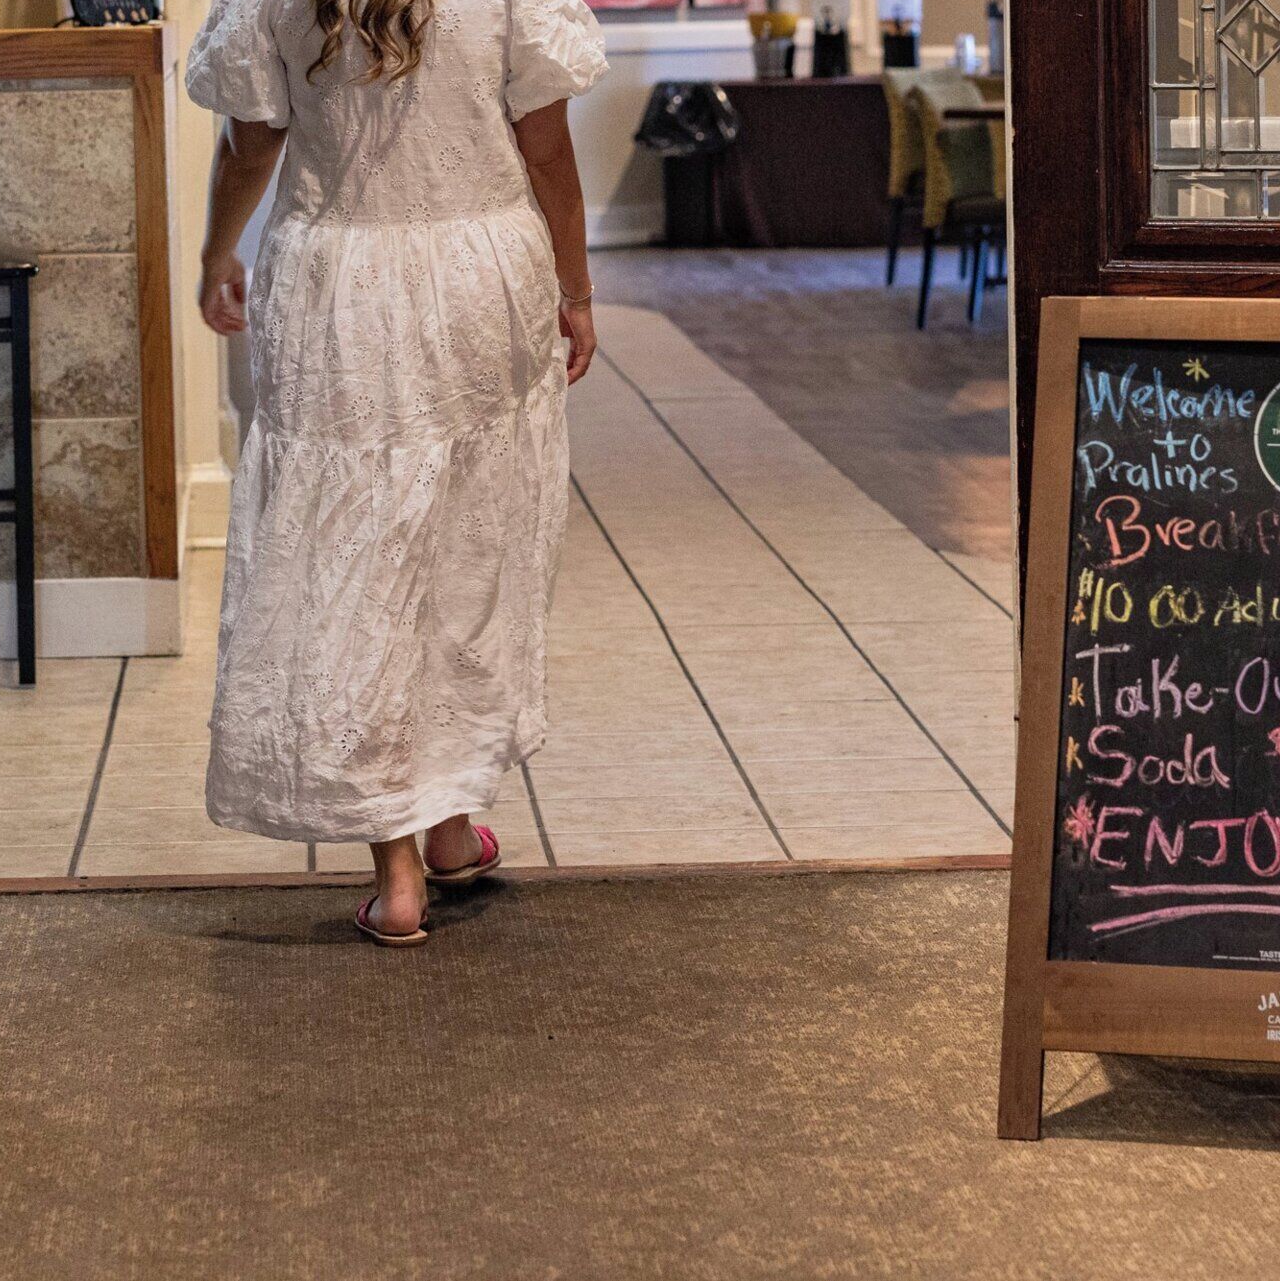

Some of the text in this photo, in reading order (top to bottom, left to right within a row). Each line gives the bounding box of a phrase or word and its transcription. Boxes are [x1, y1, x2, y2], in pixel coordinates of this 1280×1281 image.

[1083, 362, 1256, 423] Welcome
[1078, 440, 1238, 502] Pralines
[1153, 431, 1212, 462] to
[1087, 724, 1230, 788] Soda
